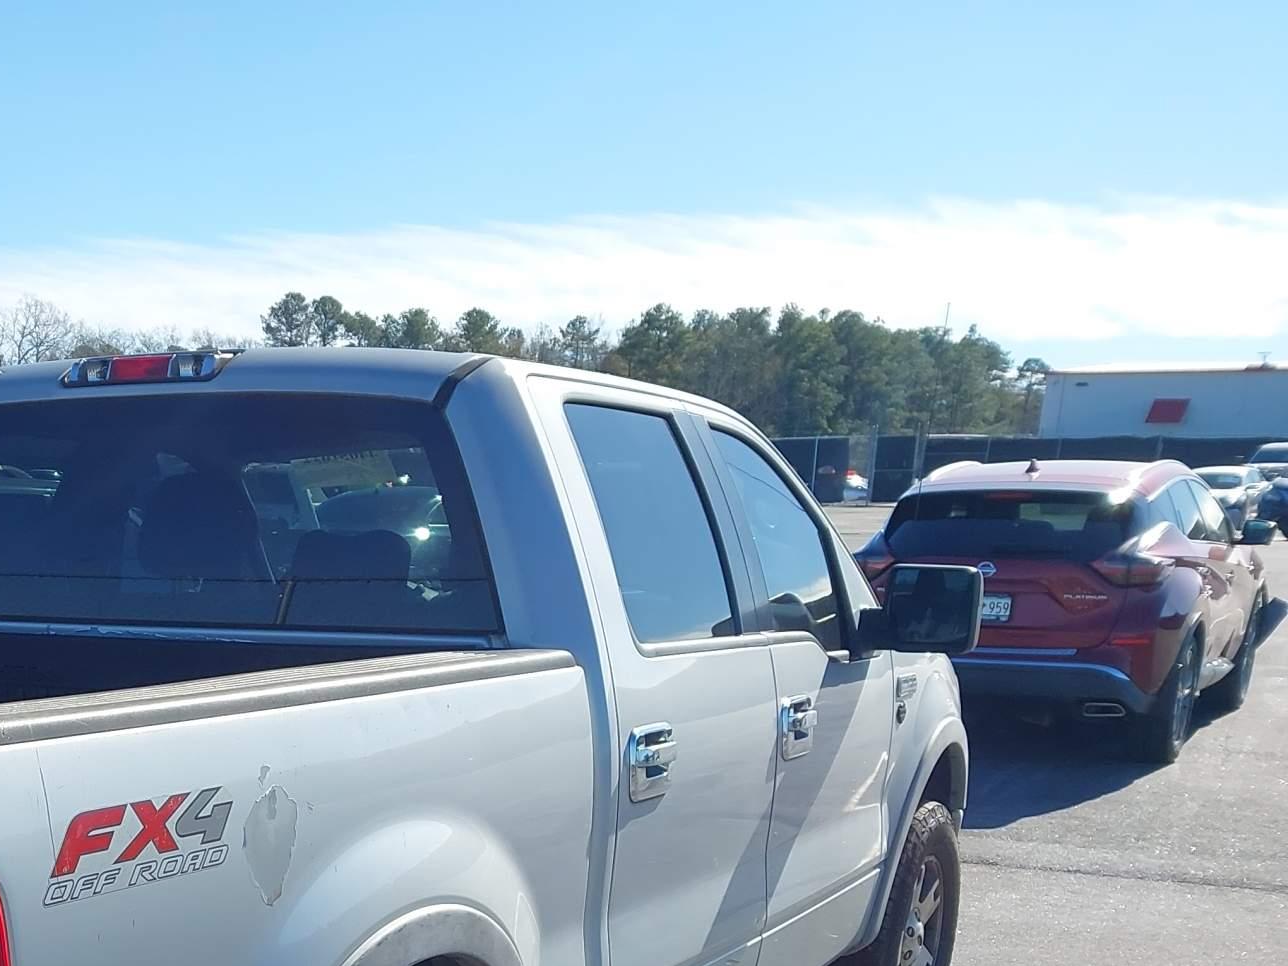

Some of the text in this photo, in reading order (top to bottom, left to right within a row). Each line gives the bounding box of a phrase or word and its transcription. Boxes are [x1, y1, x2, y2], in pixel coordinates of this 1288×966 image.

[988, 600, 1010, 615] 959
[49, 785, 233, 879] FX4
[43, 843, 230, 907] OFF ROAD
